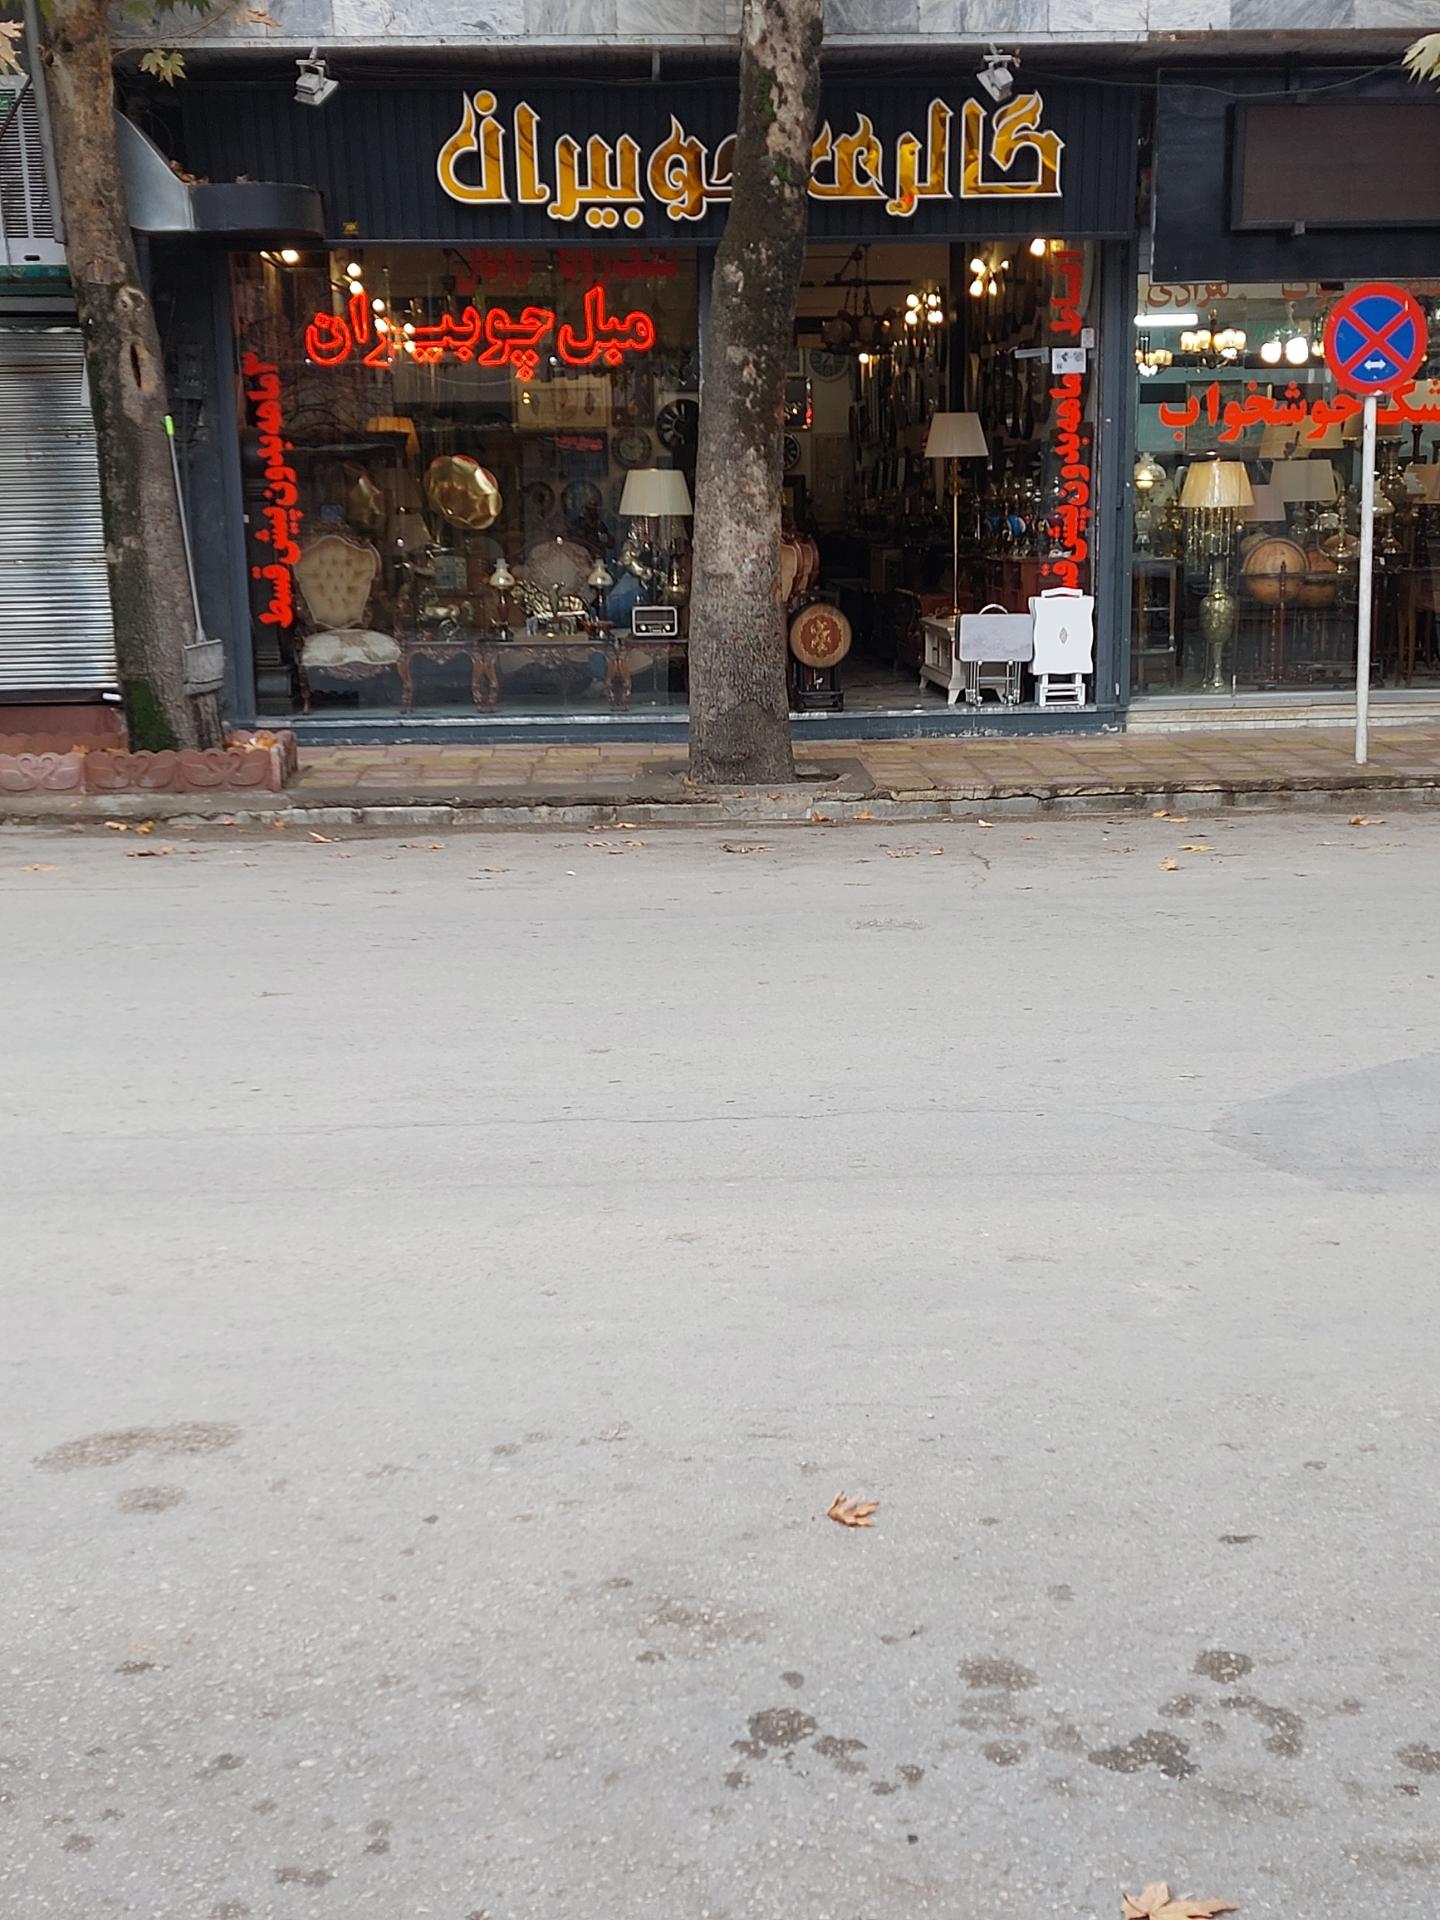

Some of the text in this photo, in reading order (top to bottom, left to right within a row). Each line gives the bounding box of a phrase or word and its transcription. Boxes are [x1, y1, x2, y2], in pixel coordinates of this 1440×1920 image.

[305, 284, 656, 382] مبل چوبیران
[257, 434, 298, 506] بدون
[1055, 432, 1090, 506] بدون
[255, 506, 304, 565] پیش
[1048, 504, 1092, 562] پیش
[252, 565, 293, 628] قسط
